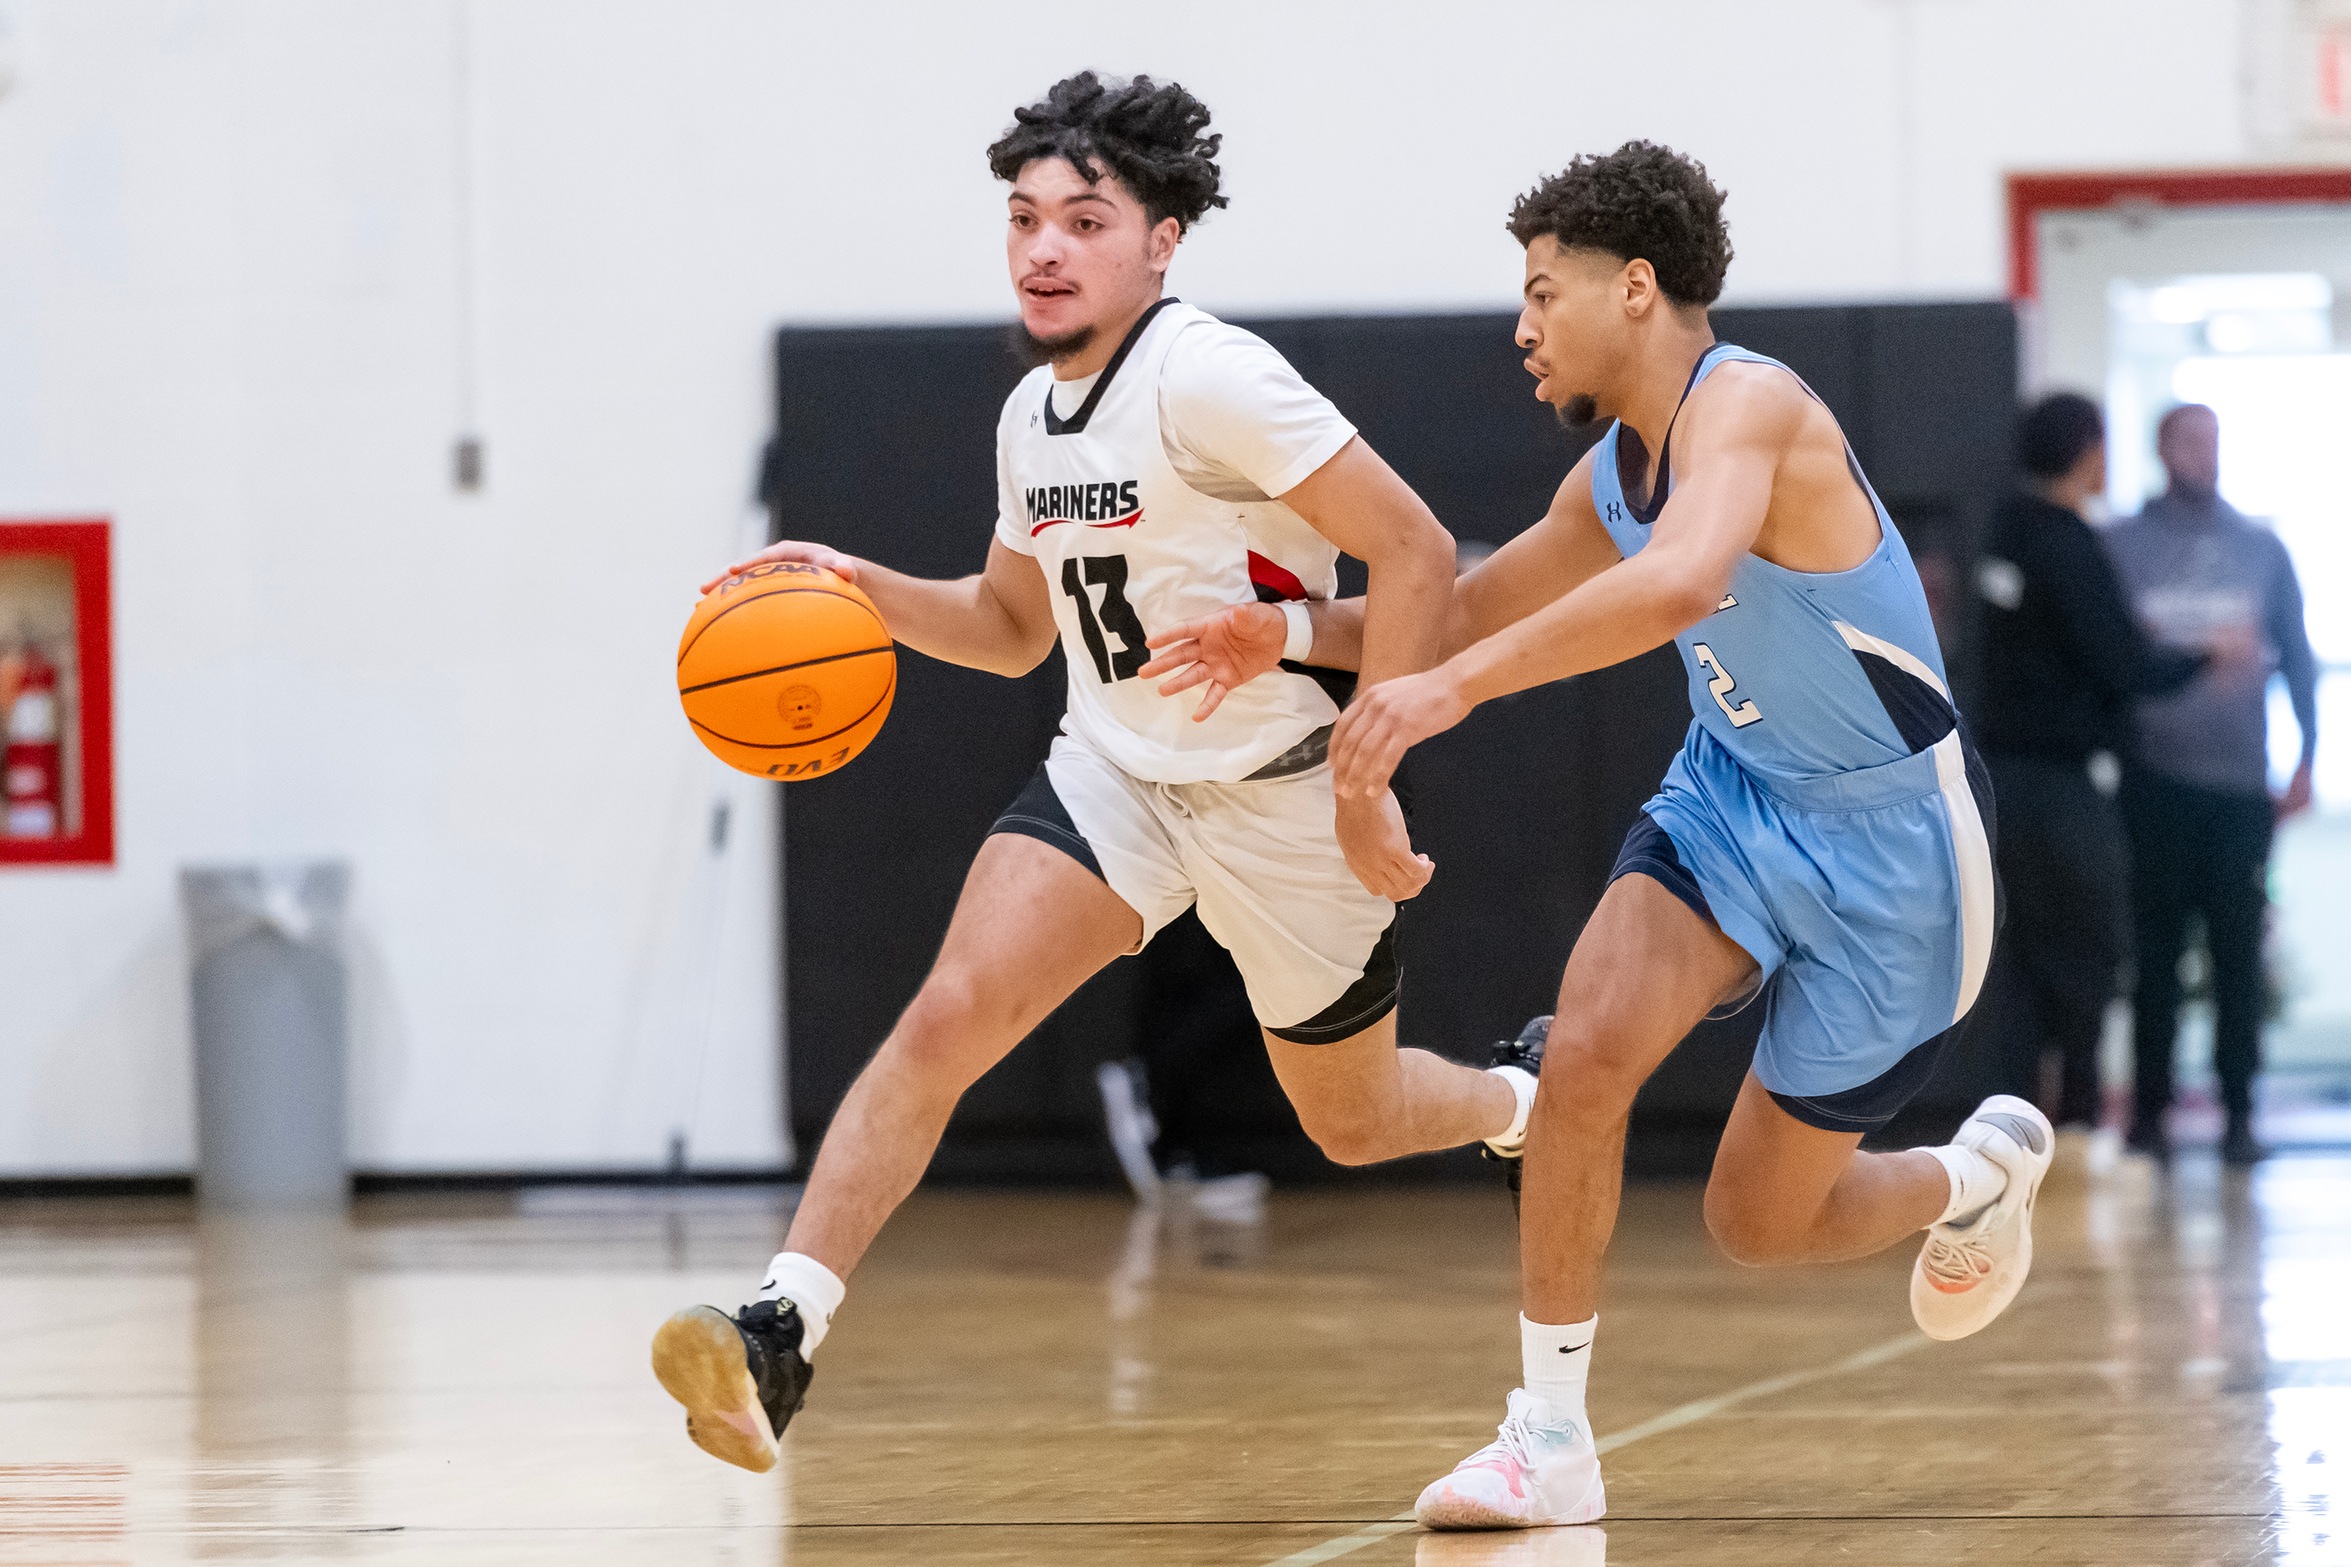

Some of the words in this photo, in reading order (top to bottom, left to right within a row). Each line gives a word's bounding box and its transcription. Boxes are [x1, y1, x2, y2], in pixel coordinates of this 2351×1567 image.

[1026, 479, 1139, 528] MARINERS
[720, 563, 820, 595] NCAA
[1061, 553, 1151, 684] 13
[1692, 641, 1764, 729] 2
